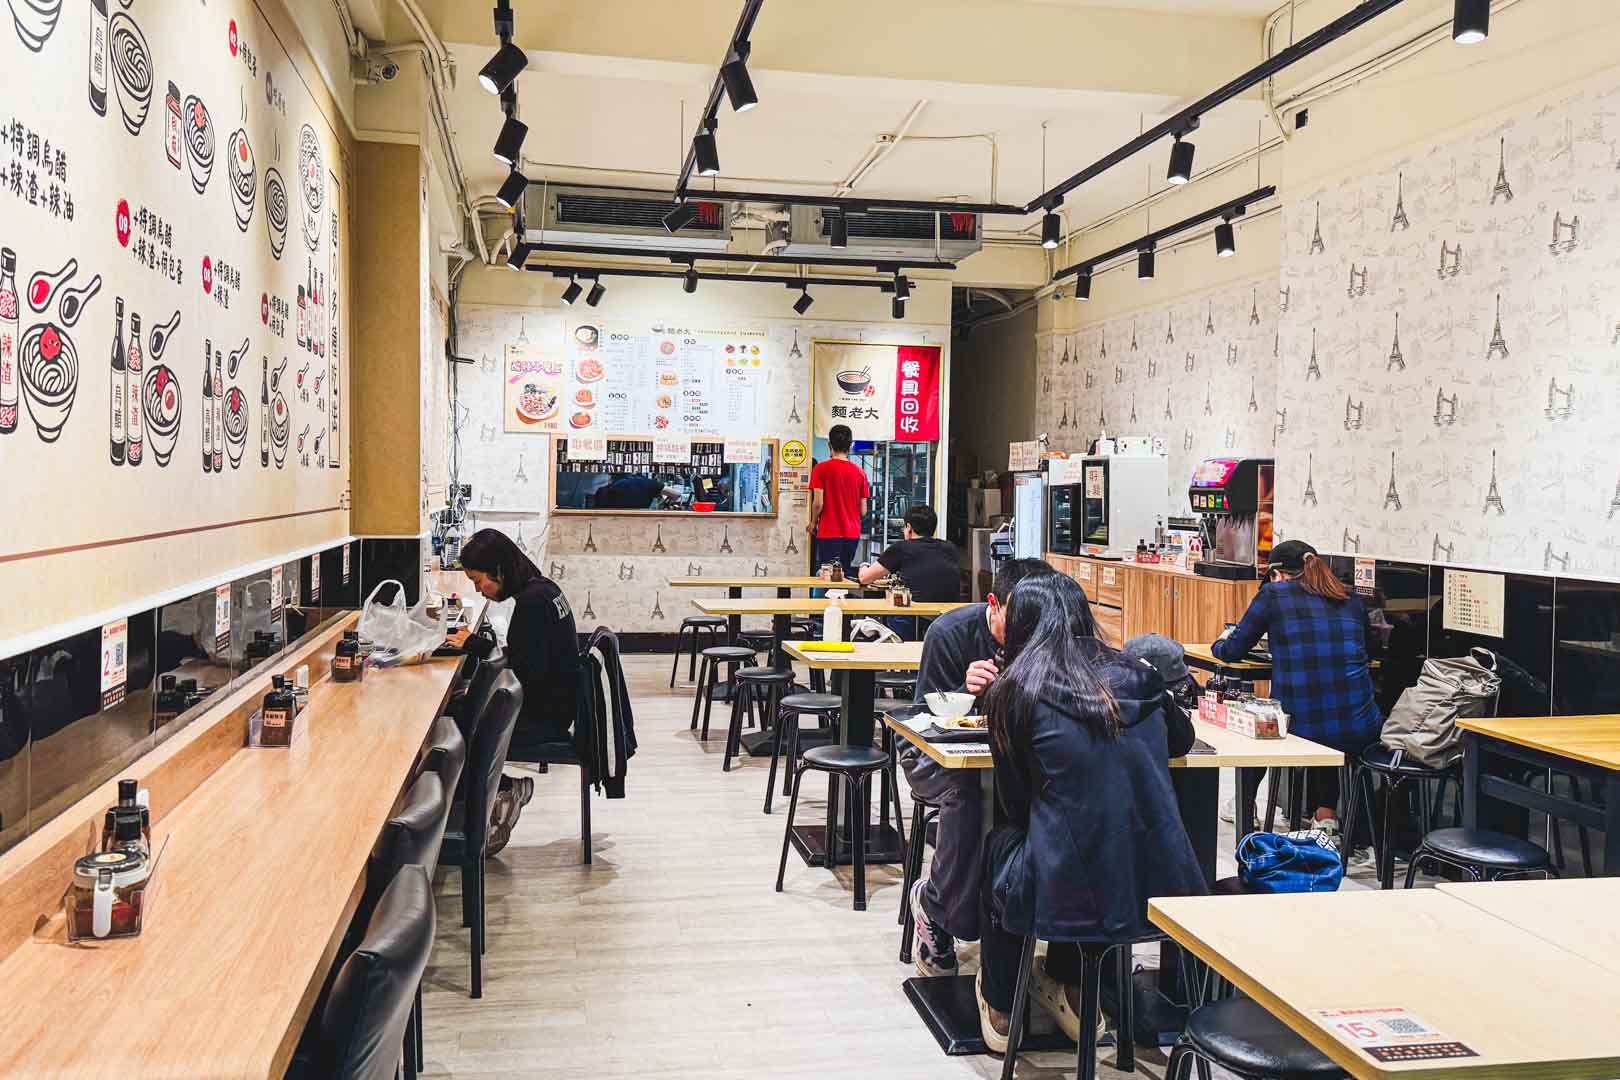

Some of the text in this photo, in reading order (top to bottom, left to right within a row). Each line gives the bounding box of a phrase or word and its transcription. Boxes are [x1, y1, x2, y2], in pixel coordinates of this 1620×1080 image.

[900, 360, 920, 433] 餐具回收
[831, 405, 880, 420] 麵老大
[1336, 1022, 1377, 1040] 15
